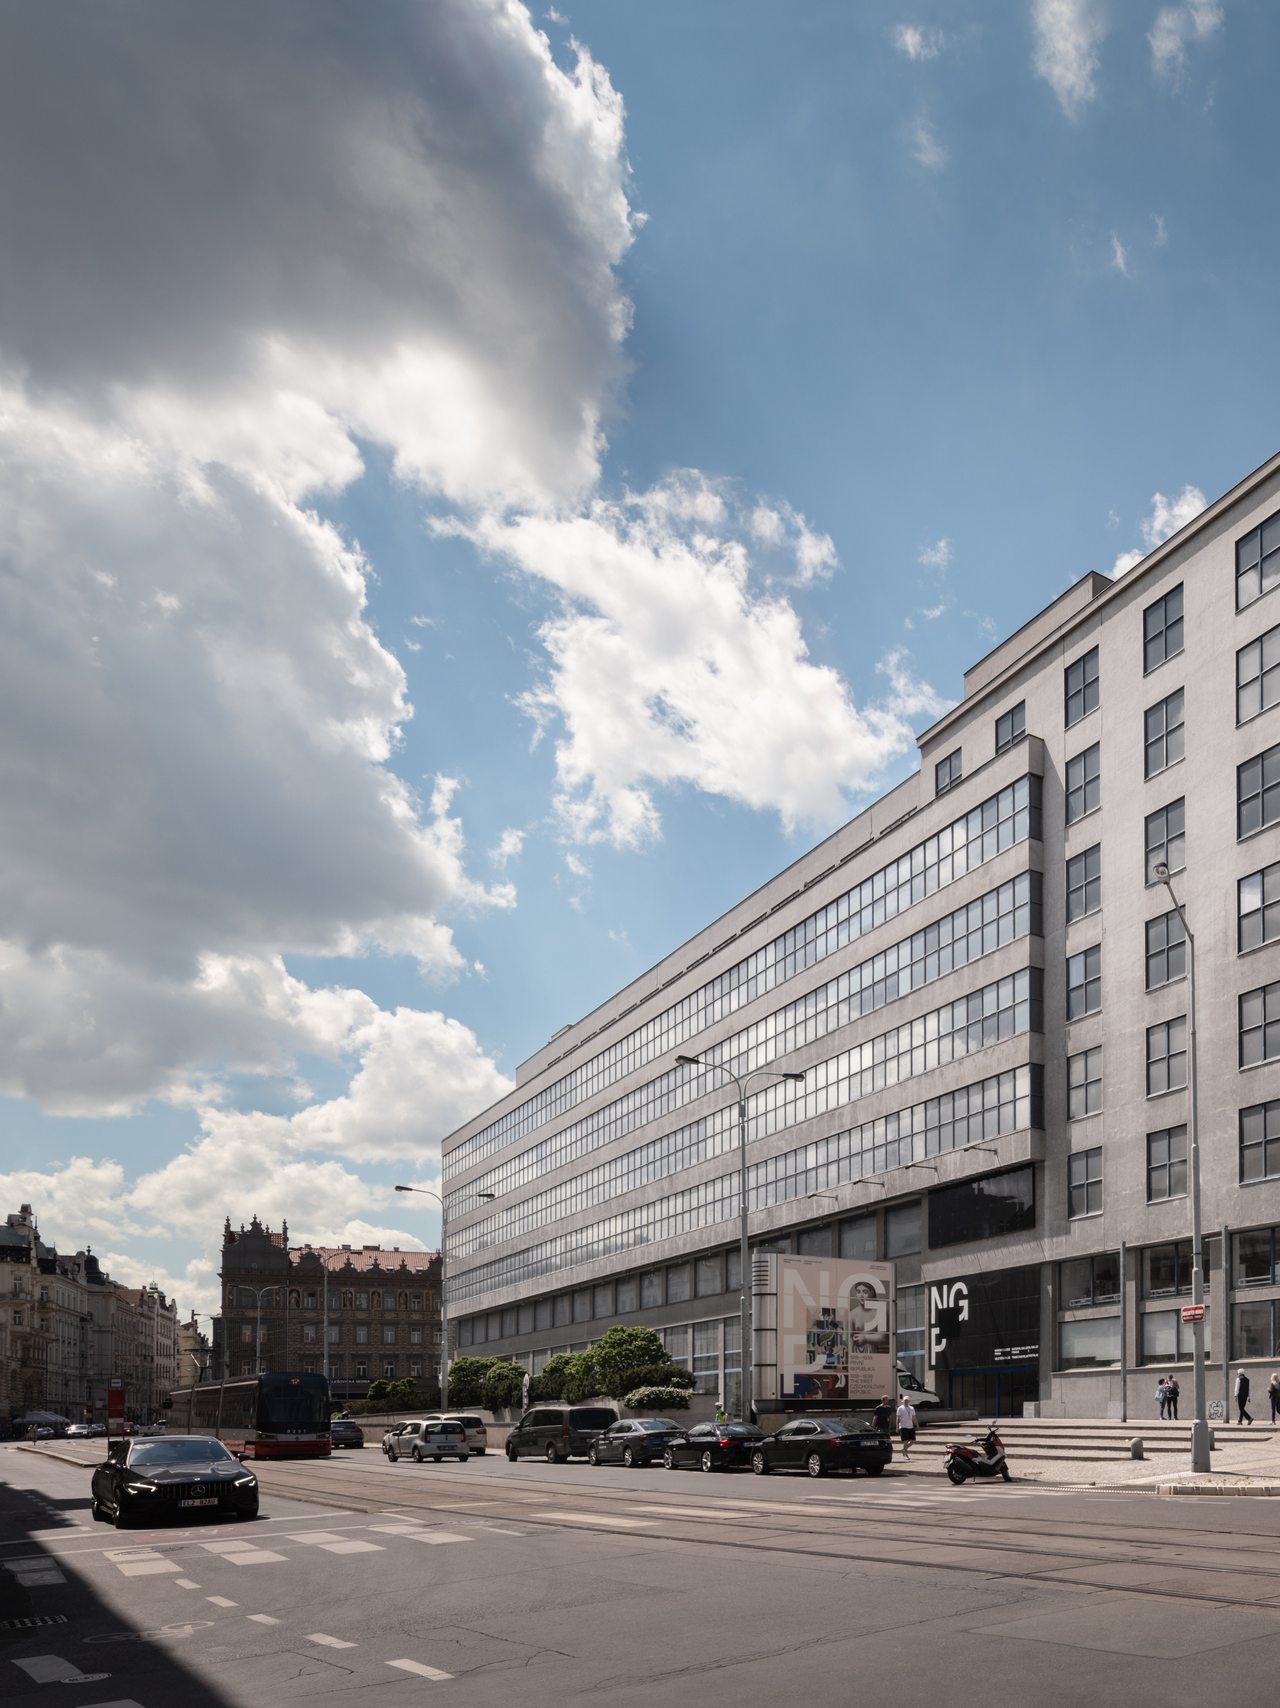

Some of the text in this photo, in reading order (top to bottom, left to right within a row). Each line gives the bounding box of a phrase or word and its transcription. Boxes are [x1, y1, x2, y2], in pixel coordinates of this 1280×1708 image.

[784, 1268, 887, 1332] NG
[931, 1281, 969, 1324] NG
[784, 1334, 827, 1394] P
[931, 1327, 947, 1366] P
